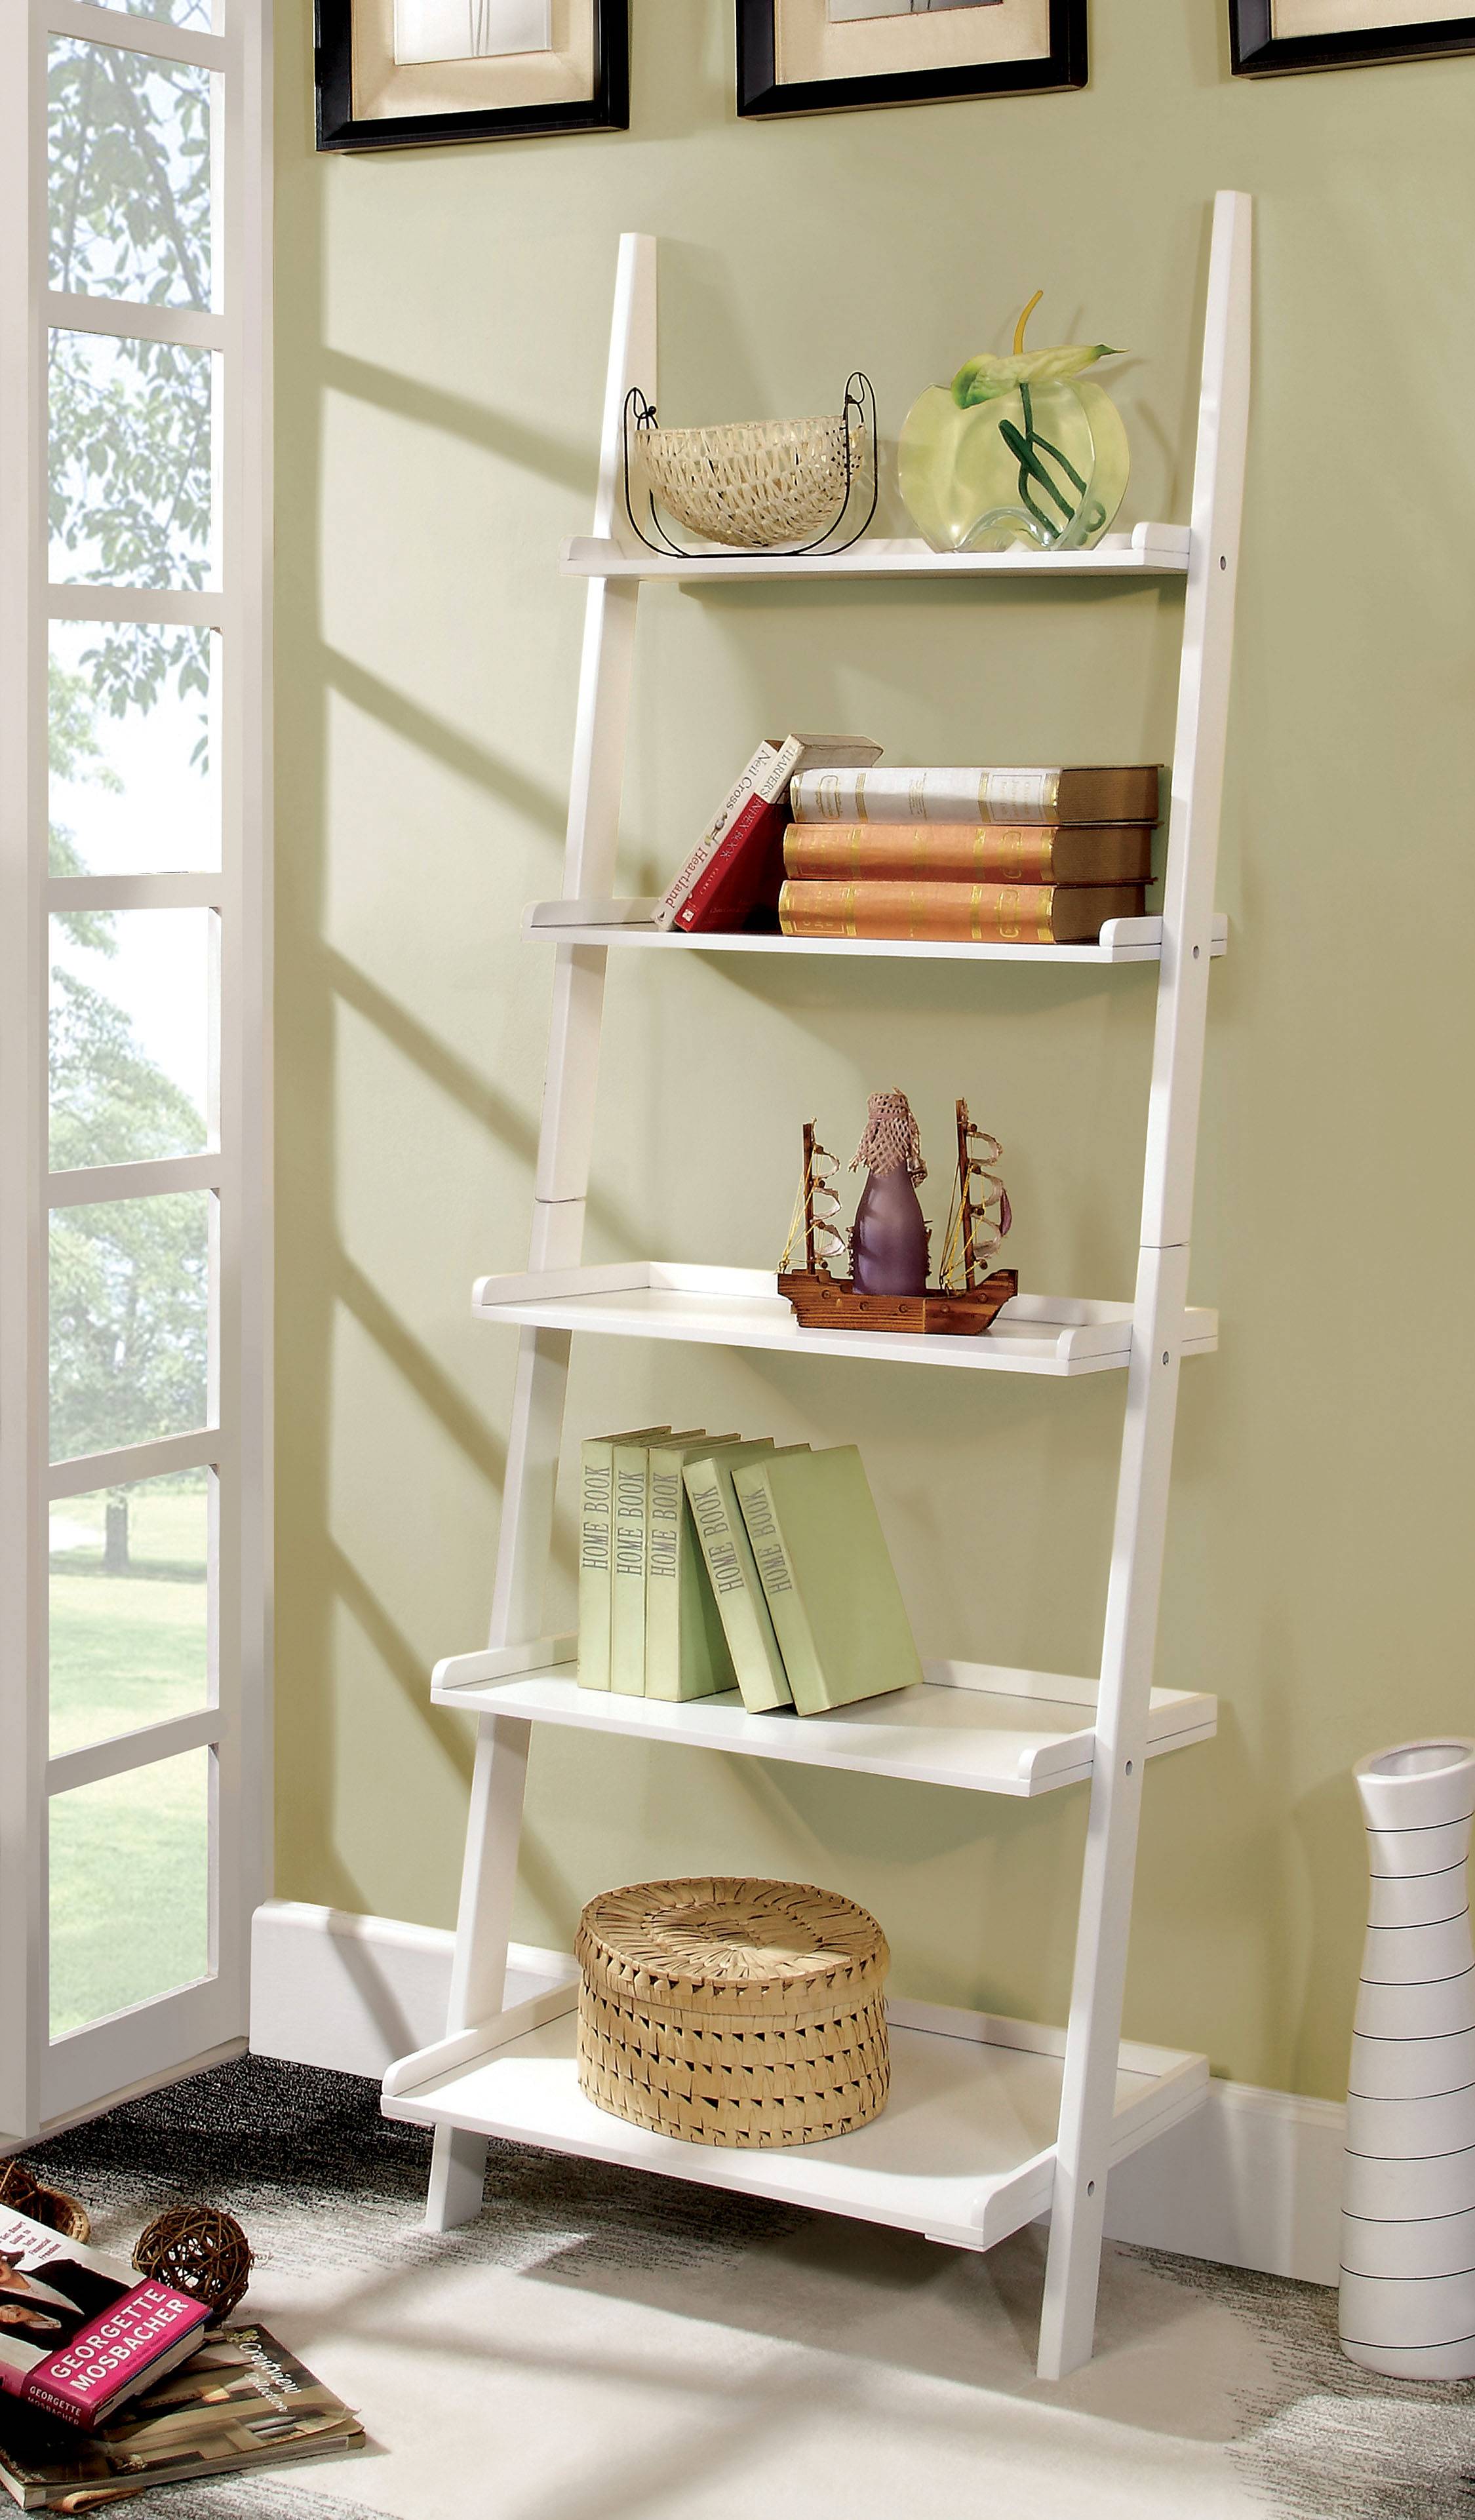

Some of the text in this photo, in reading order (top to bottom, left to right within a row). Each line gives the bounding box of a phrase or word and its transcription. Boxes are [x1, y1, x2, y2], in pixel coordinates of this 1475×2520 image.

[726, 749, 772, 810] Neil Cross
[760, 750, 794, 798] HARPER'S
[739, 797, 764, 832] INDEX
[665, 847, 709, 908] Heartland
[582, 1465, 610, 1570] HOME BOOK
[616, 1471, 644, 1576] HOME BOOK
[650, 1472, 678, 1579] HOME BOOK
[692, 1486, 745, 1595] HOME BOOK
[741, 1486, 793, 1595] HOME BOOK
[28, 2237, 52, 2255] Financial
[38, 2243, 62, 2260] Freedom
[50, 2288, 167, 2378] GEORGETTE
[69, 2298, 189, 2392] MOSBACHER
[239, 2342, 302, 2394] Crestview
[28, 2396, 80, 2426] MOSBACHER
[30, 2386, 83, 2417] GEORGETTE
